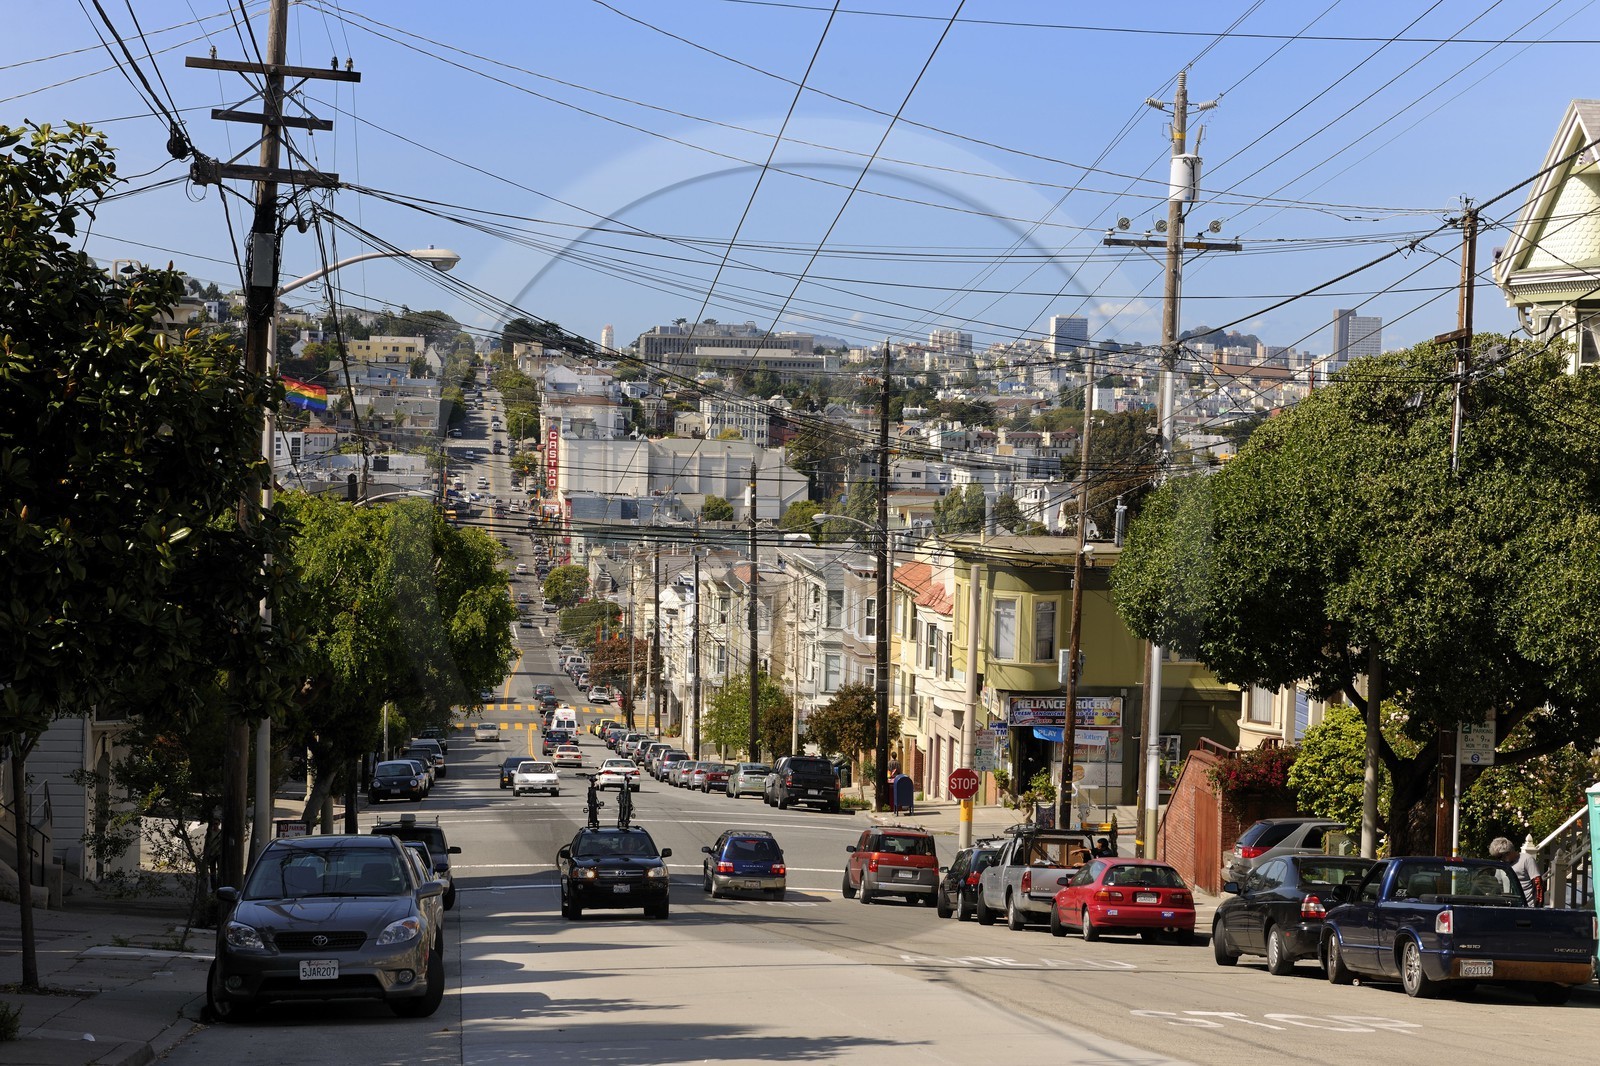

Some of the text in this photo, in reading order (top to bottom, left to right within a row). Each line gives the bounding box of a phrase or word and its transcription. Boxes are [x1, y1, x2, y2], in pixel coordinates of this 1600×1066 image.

[548, 431, 558, 487] CASTRO
[1017, 699, 1113, 710] RELIANCE ROCERY
[1038, 729, 1058, 737] PLAY
[950, 778, 977, 790] STOP
[302, 966, 337, 977] 5JAR207
[1129, 1009, 1423, 1035] STOP
